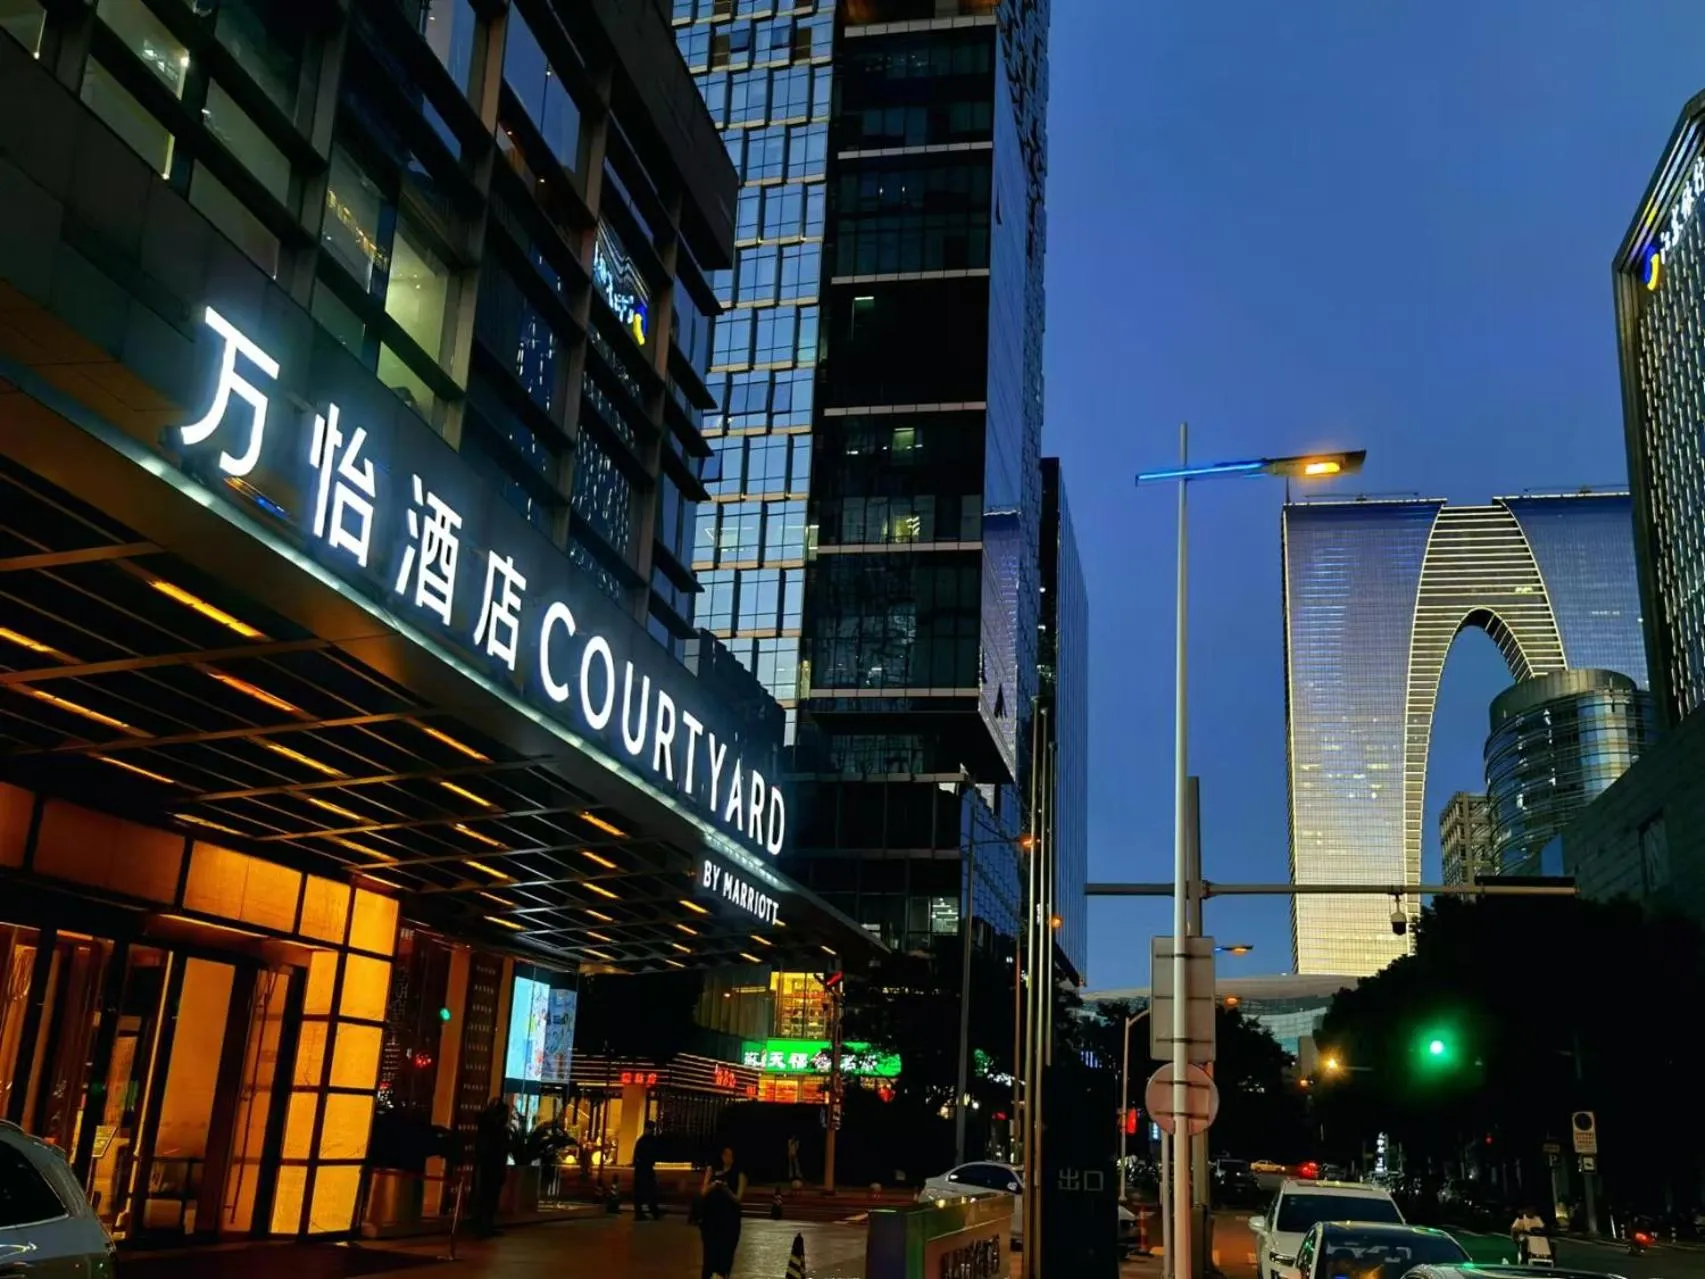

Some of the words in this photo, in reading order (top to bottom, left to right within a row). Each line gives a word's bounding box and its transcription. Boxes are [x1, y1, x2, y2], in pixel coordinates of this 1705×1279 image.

[180, 306, 527, 671] 万怡酒店
[540, 602, 785, 856] COURTYARD
[703, 860, 721, 891] BY
[723, 871, 779, 926] MARRIOTT
[1057, 1167, 1105, 1193] 出口
